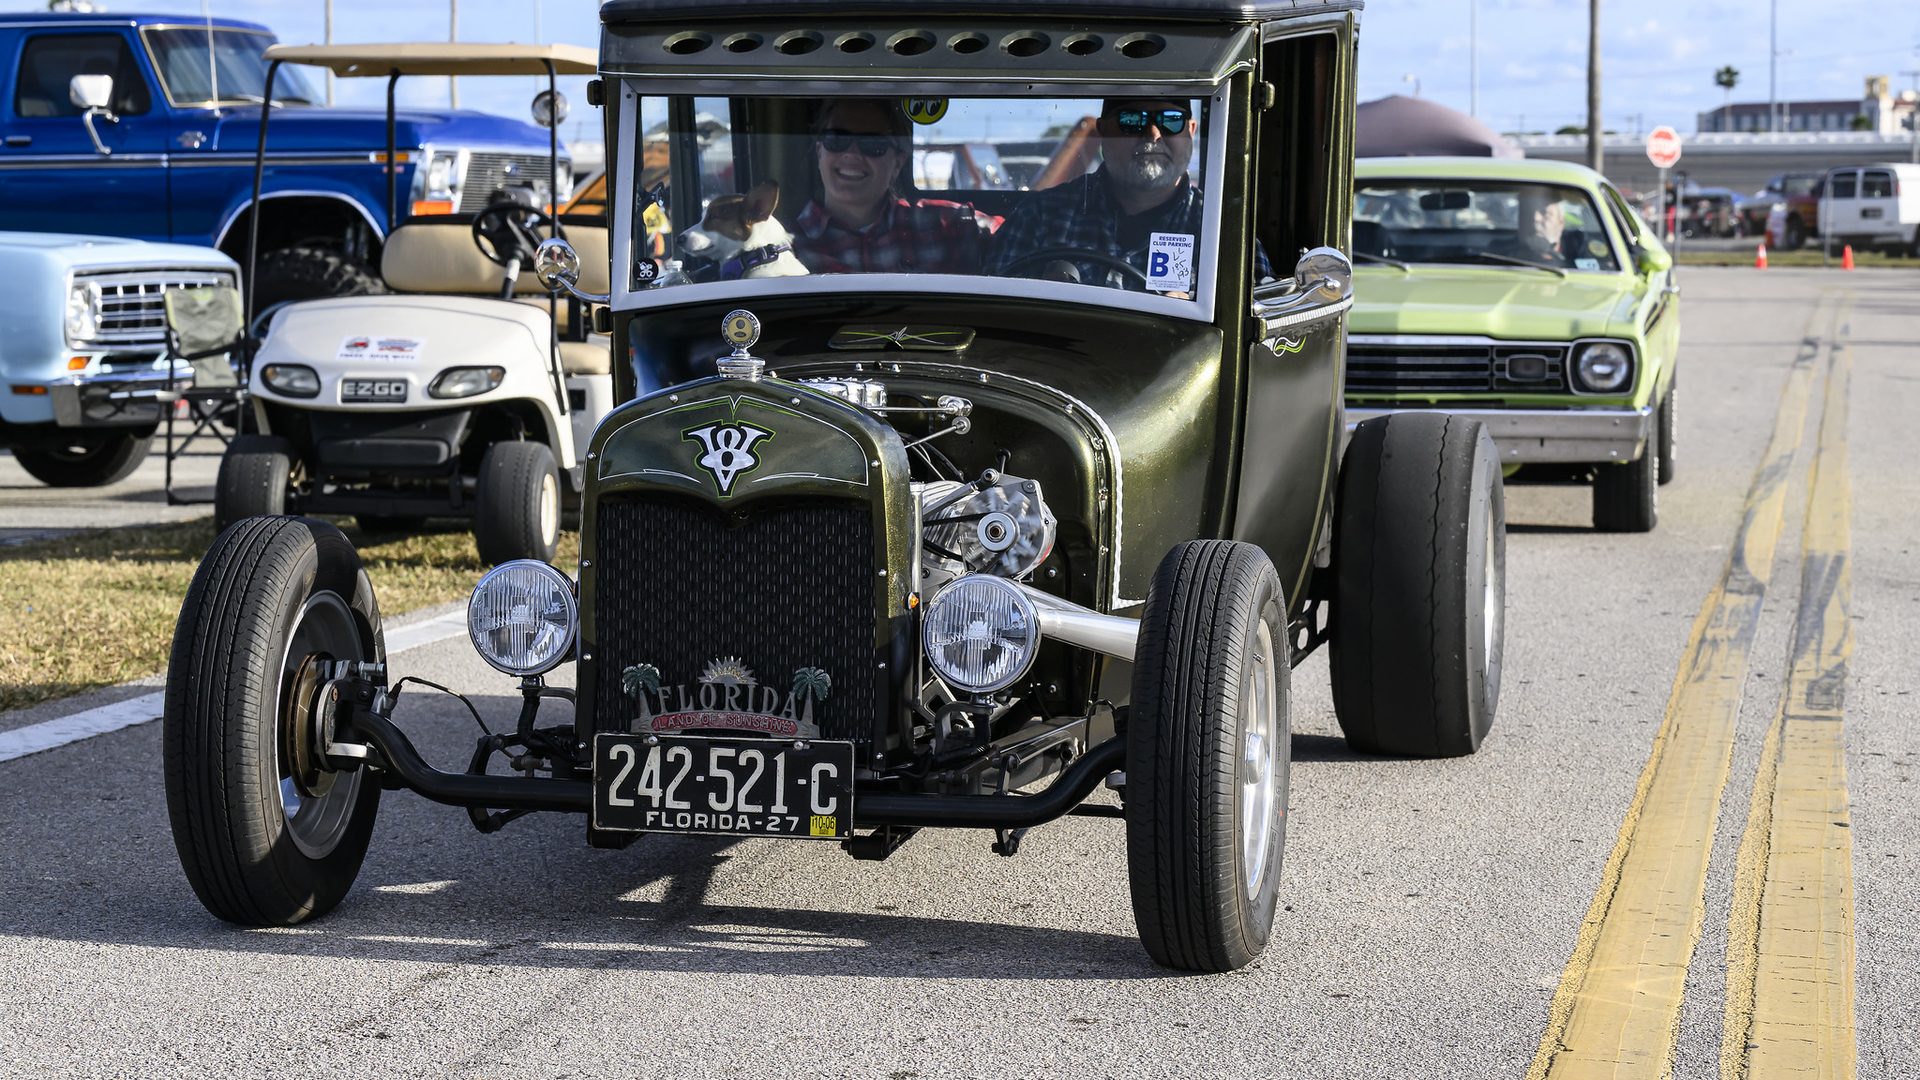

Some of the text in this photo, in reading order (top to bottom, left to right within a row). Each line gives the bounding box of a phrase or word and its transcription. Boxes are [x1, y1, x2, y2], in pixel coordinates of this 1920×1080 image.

[1150, 252, 1169, 277] B
[657, 683, 797, 720] FLORIDA
[658, 714, 793, 733] LAND OF SUNSHINE
[609, 744, 838, 815] 242-521-C
[646, 811, 800, 832] FLORIDA-27
